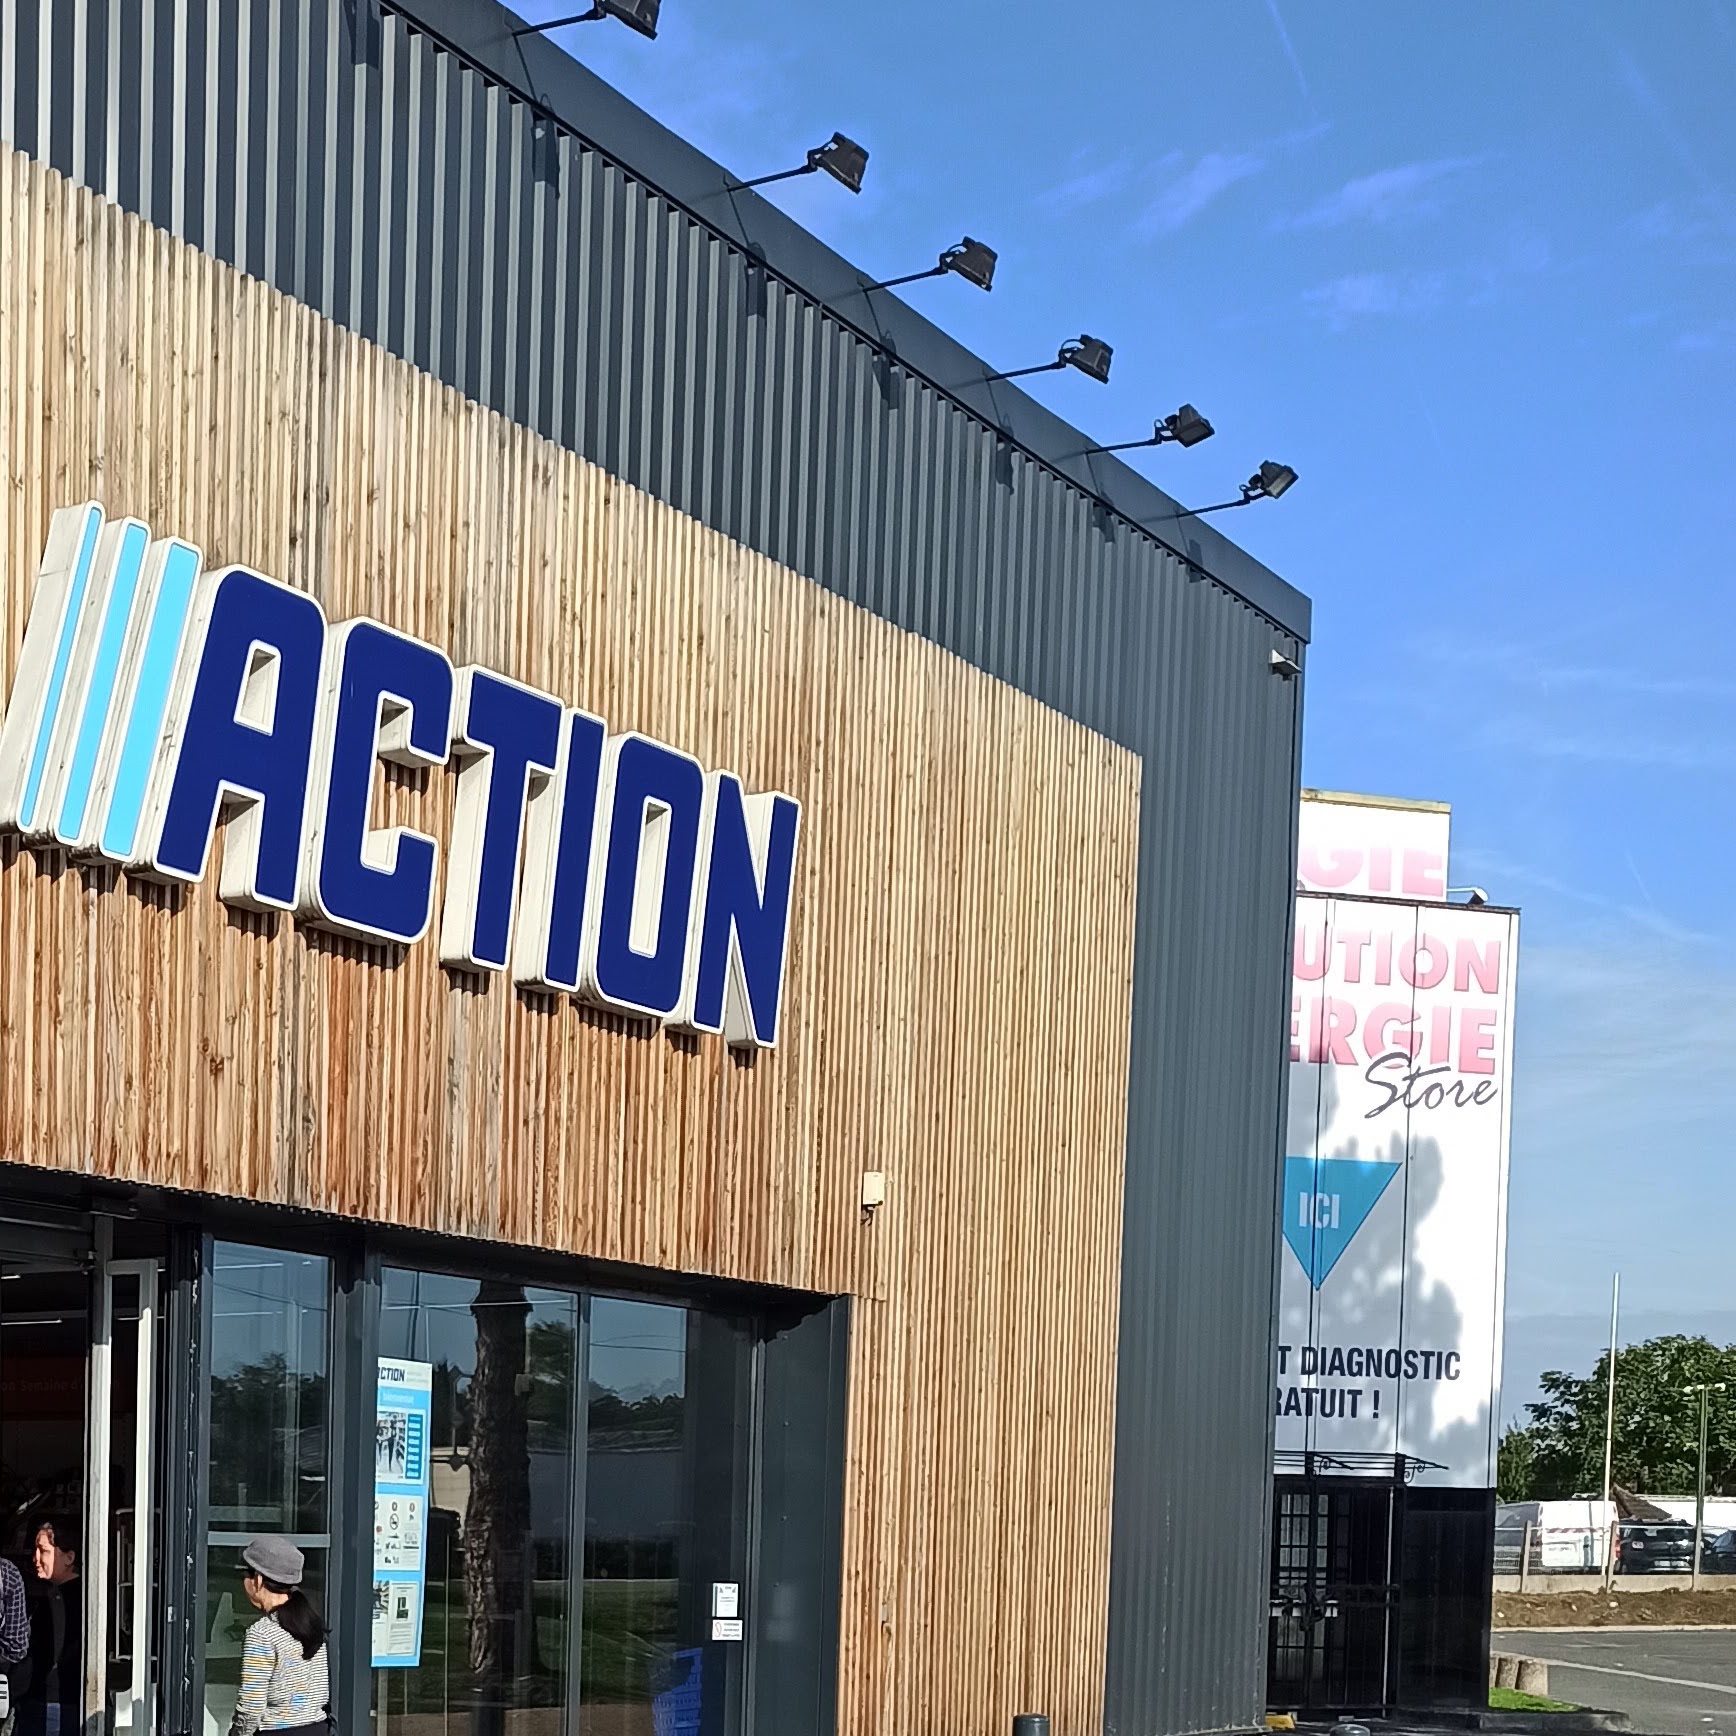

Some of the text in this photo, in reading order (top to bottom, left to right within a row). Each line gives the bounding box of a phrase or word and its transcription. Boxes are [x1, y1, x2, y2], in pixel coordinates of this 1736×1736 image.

[151, 562, 804, 1050] ACTION
[1290, 995, 1498, 1075] RGIE
[1364, 1051, 1499, 1119] Store
[1299, 1192, 1341, 1229] ICI
[377, 1366, 406, 1382] CTION
[1300, 1346, 1462, 1381] DIAGNOSTIC
